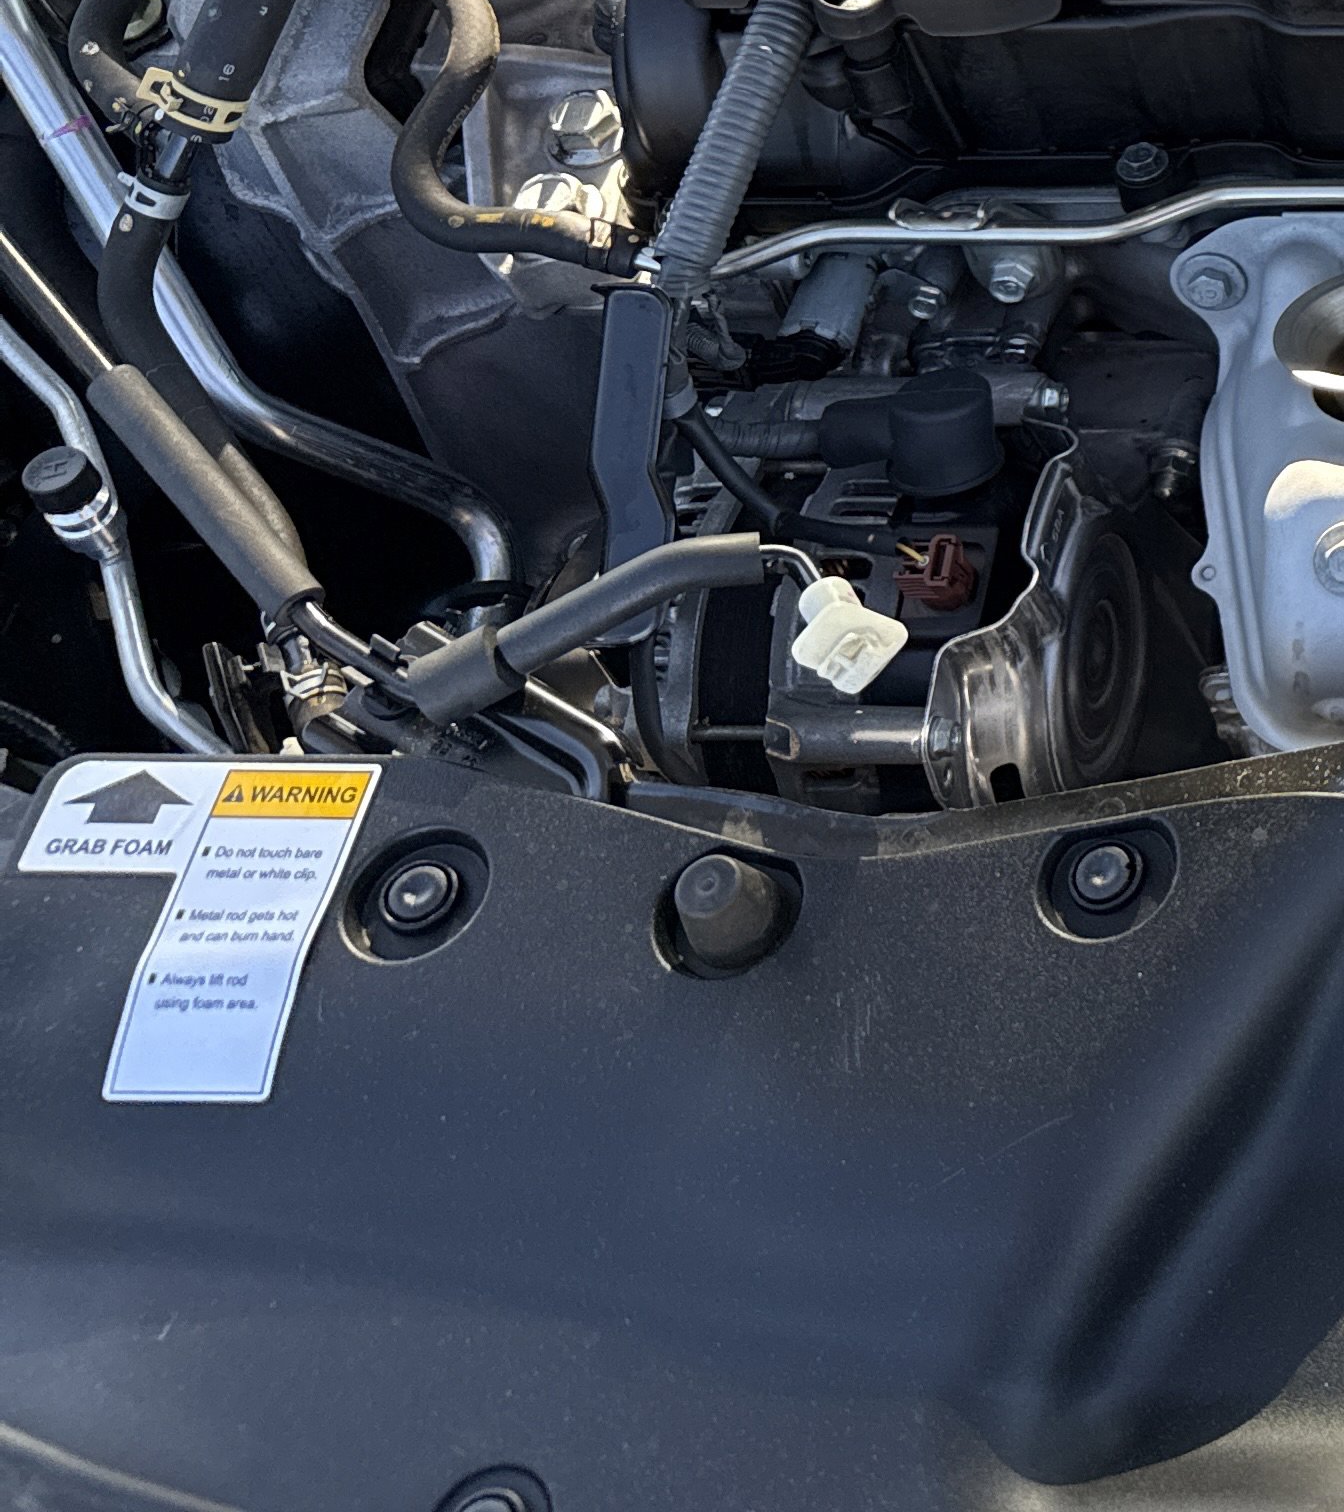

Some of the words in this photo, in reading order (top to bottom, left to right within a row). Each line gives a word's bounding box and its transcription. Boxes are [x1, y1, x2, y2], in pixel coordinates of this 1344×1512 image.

[251, 786, 358, 804] WARNING
[45, 838, 105, 856] GRAB
[110, 839, 173, 856] FOAM
[215, 846, 234, 859] Do
[236, 846, 257, 859] not
[259, 846, 292, 859] touch
[294, 846, 323, 859] bare
[206, 867, 242, 880] metal
[243, 869, 258, 880] or
[259, 867, 292, 880] white
[189, 909, 225, 921] Metal
[226, 909, 249, 921] rod
[247, 910, 275, 924] gets
[277, 909, 300, 921] hot
[179, 930, 206, 942] and
[205, 932, 229, 942] can
[160, 973, 206, 989] Always
[226, 973, 249, 987] rod
[154, 996, 190, 1012] using
[192, 996, 225, 1009] foam
